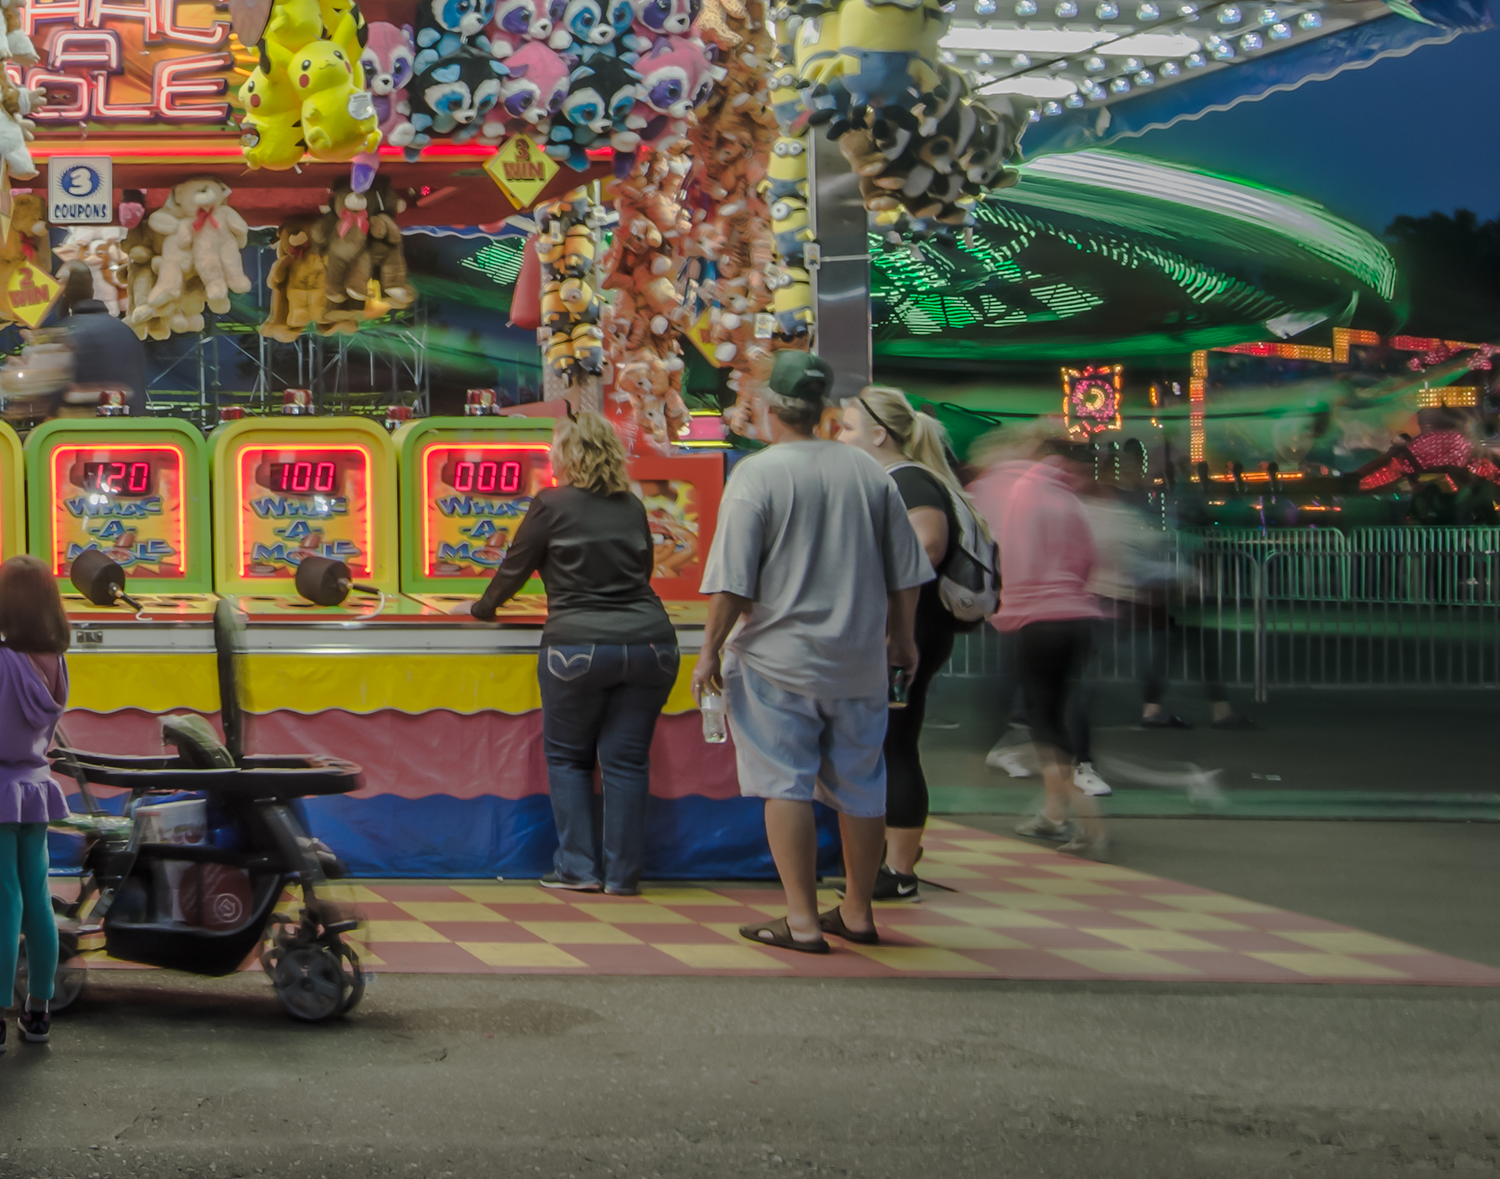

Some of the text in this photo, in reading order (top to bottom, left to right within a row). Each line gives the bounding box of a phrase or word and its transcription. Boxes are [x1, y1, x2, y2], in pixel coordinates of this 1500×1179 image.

[48, 28, 125, 74] A
[67, 166, 94, 196] 3
[503, 161, 545, 182] WIN
[54, 203, 108, 219] COUPONS
[18, 266, 35, 289] 2
[8, 283, 50, 309] WIN
[95, 462, 149, 492] 120
[281, 461, 336, 492] 100
[454, 461, 521, 492] 000
[66, 496, 162, 517] WHAC
